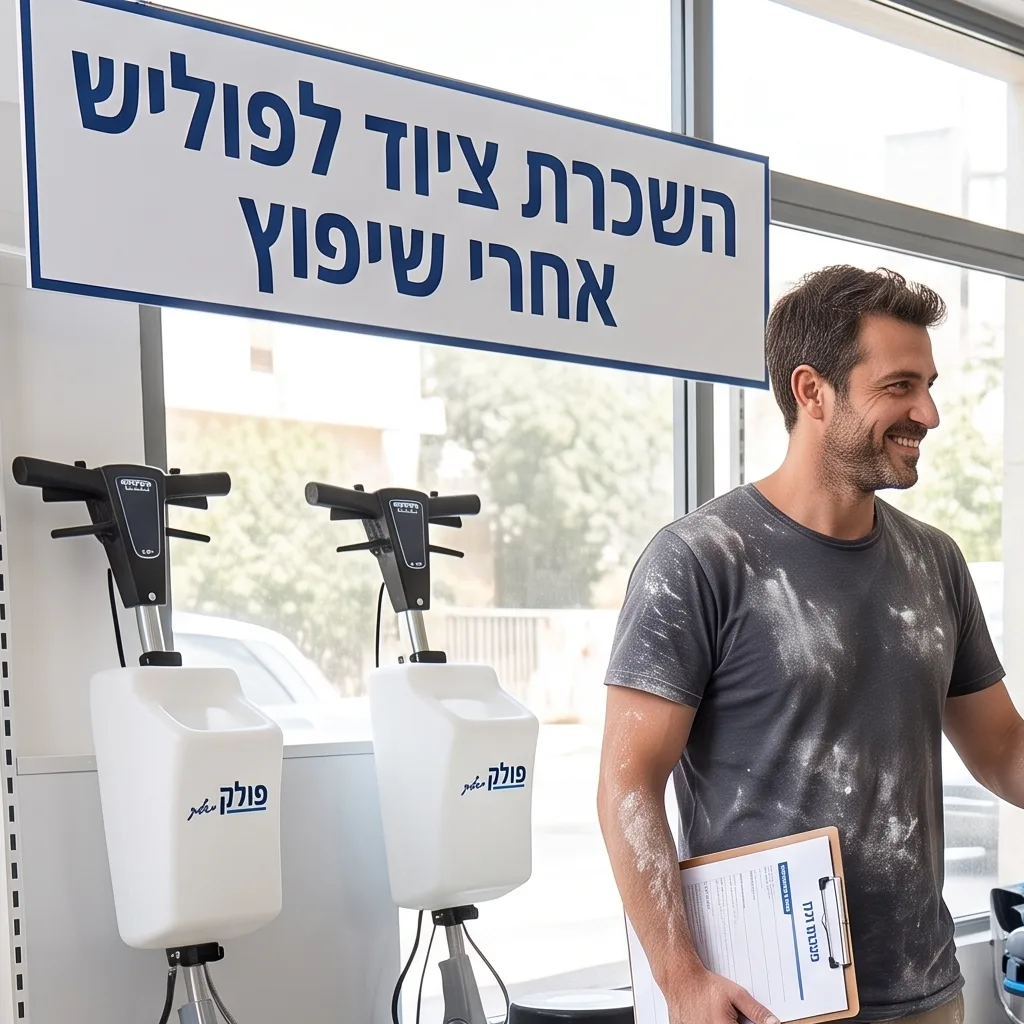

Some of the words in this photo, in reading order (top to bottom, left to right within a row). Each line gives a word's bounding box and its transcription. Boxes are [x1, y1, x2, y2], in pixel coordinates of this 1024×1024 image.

[71, 50, 342, 177] לפוליש
[364, 115, 500, 210] ציוד
[520, 151, 737, 258] השכרת
[238, 196, 446, 298] שיפוץ
[469, 239, 618, 328] אחרי
[219, 780, 268, 815] פולק
[487, 761, 526, 791] פולק
